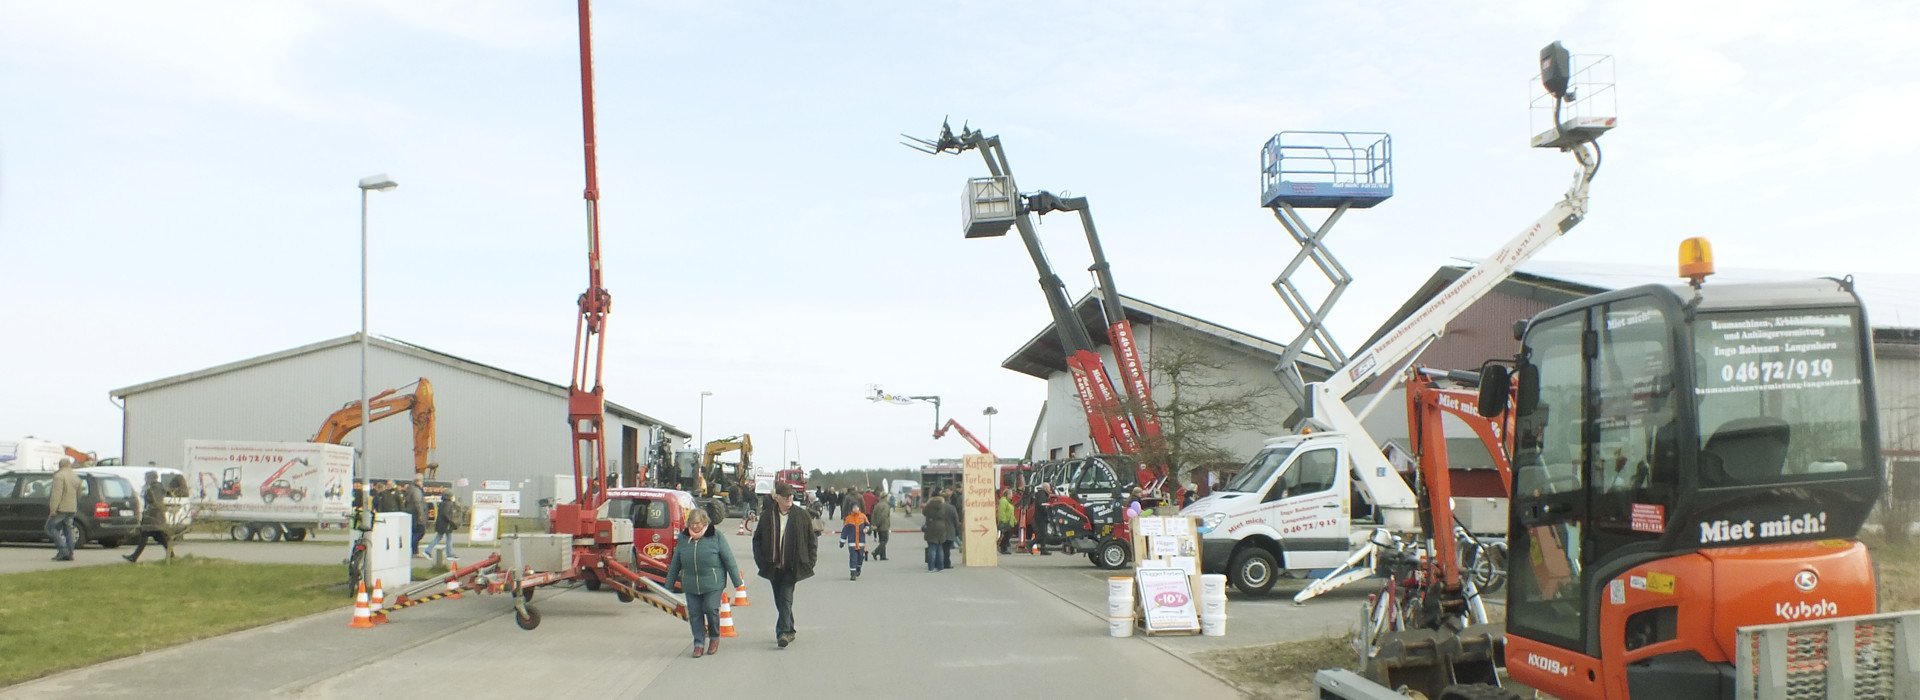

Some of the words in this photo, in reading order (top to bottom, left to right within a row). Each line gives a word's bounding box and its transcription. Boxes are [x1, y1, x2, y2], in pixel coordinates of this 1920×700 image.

[1724, 332, 1740, 341] und
[1714, 346, 1737, 357] Ingo
[1439, 393, 1459, 410] Miet
[966, 456, 993, 470] Kaffee
[968, 485, 993, 497] Suppe
[1228, 522, 1246, 535] Miet
[1700, 519, 1755, 544] Miet
[1759, 512, 1827, 538] mich!
[1775, 598, 1838, 620] Kubota
